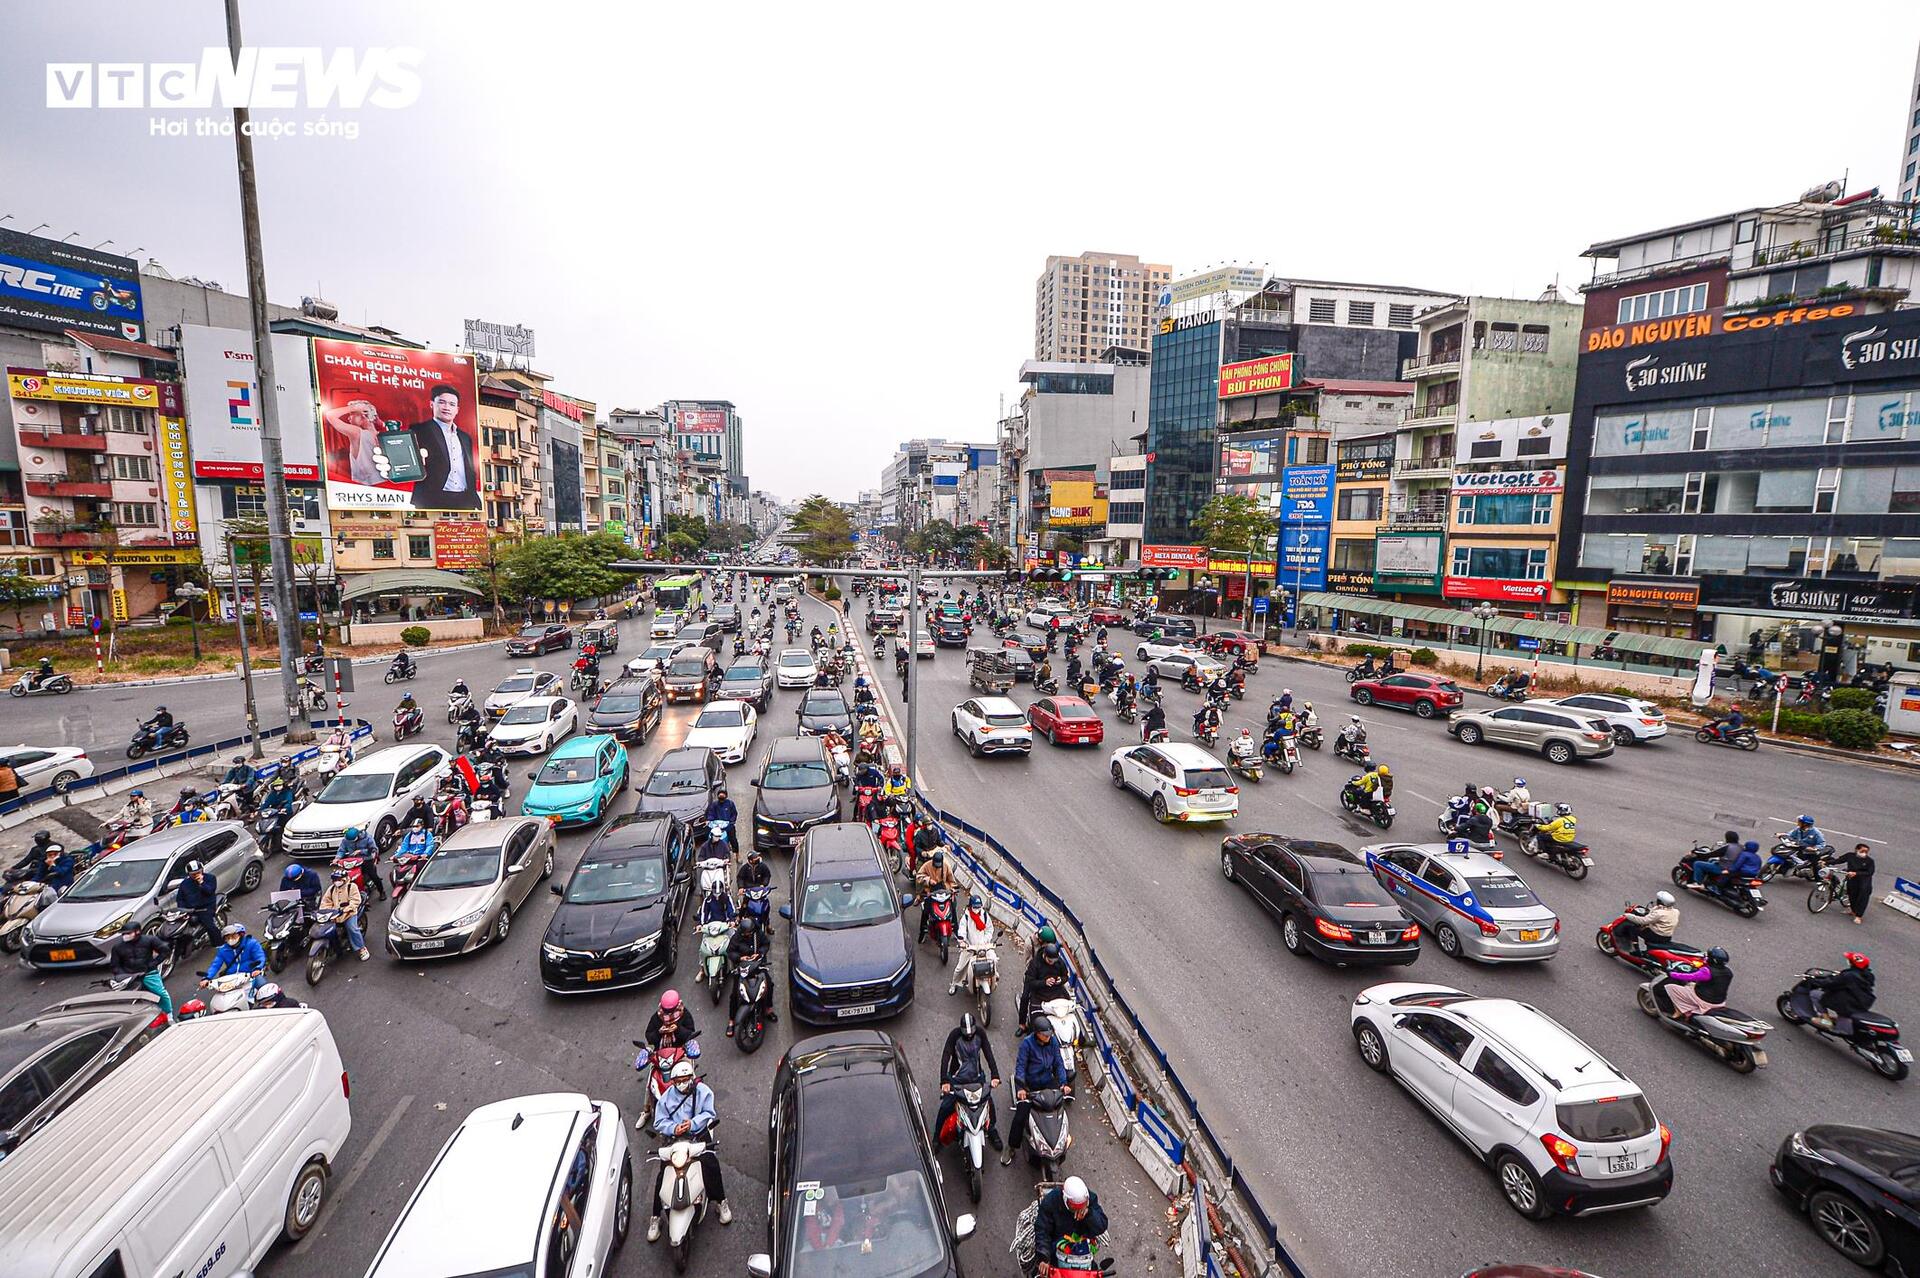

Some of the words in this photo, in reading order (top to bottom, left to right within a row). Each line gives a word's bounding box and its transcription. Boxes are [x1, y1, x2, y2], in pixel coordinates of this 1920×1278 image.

[52, 282, 84, 300] TIRE
[79, 320, 92, 328] AN
[1177, 309, 1217, 331] HANOI
[1588, 326, 1626, 352] ĐÀO
[1631, 313, 1713, 346] NGUYÊN
[1722, 303, 1854, 333] Coffee
[1858, 341, 1887, 364] 30
[324, 354, 364, 369] CHĂM
[365, 359, 391, 373] SÓC
[393, 363, 418, 377] ĐÀN
[419, 367, 442, 380] ÔNG
[381, 374, 400, 389] HỆ
[402, 376, 425, 390] MỚI
[1638, 368, 1658, 387] 30
[1341, 460, 1360, 470] PHỞ
[1360, 458, 1387, 470] TỐNG
[1456, 473, 1535, 486] Vietlott
[336, 492, 373, 503] RHYS
[376, 493, 405, 503] MAN
[1296, 500, 1316, 509] FDA
[175, 531, 196, 541] 341
[1503, 584, 1534, 593] Vietlott
[1611, 586, 1628, 597] ĐÀO
[1629, 588, 1664, 599] NGUYÊN
[1664, 591, 1694, 602] COFFEE
[1780, 590, 1799, 605] 30
[1851, 595, 1877, 605] 407
